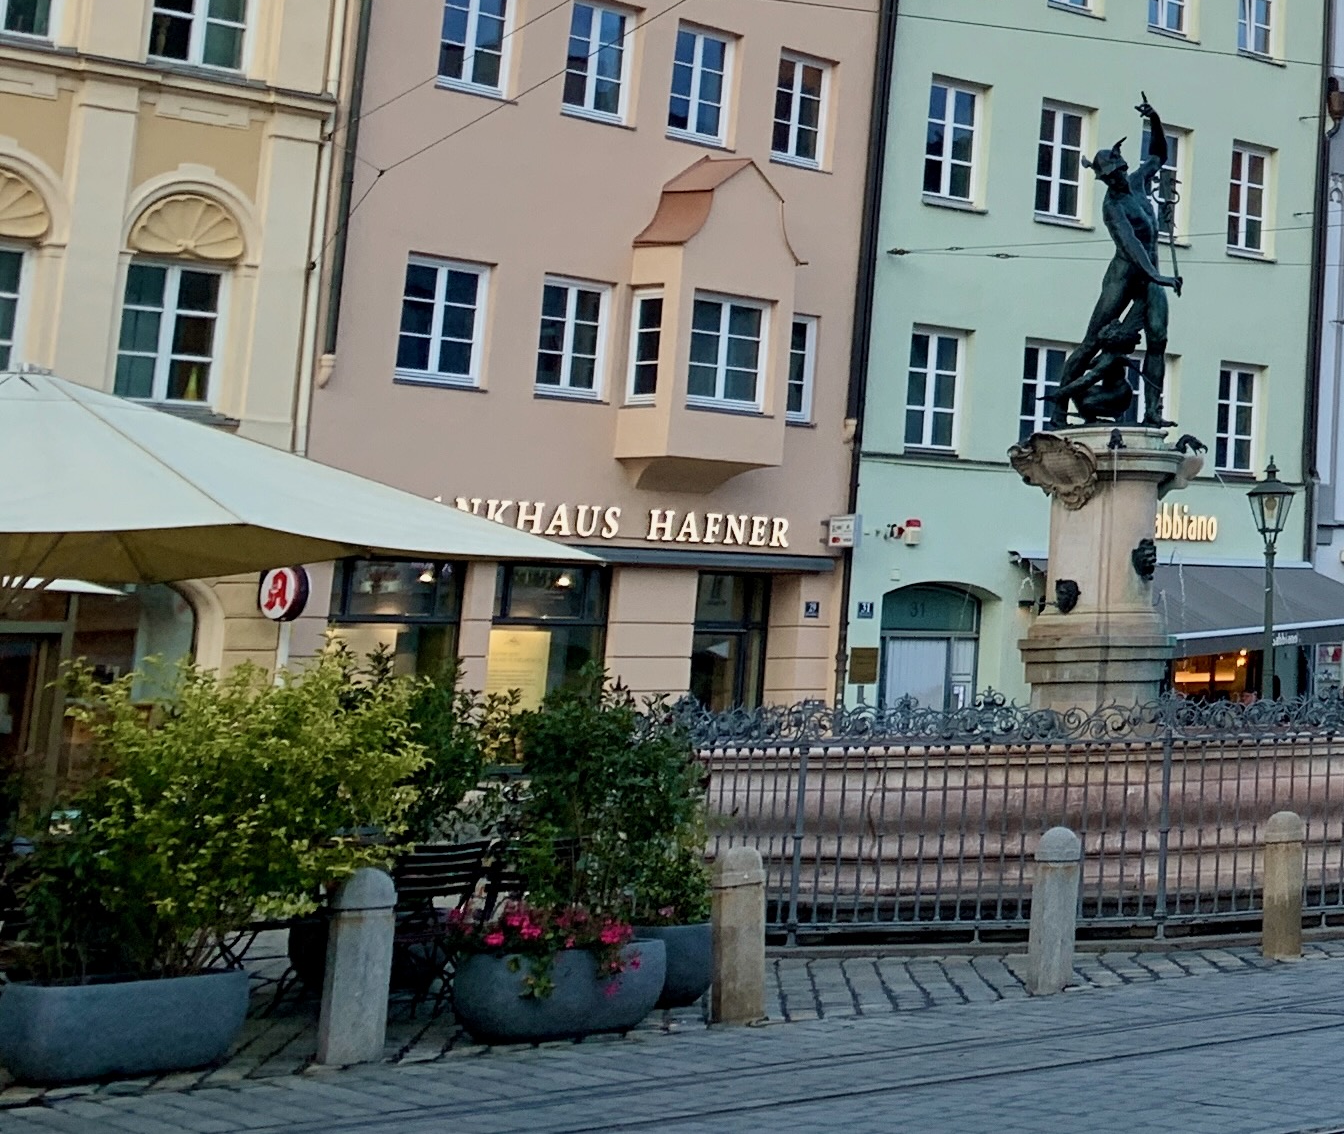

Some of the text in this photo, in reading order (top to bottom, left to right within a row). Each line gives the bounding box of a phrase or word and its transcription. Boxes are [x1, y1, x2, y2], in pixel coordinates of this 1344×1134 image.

[433, 495, 789, 548] NKHAUS HAFNER
[1155, 502, 1217, 541] abbiano
[264, 570, 287, 611] A
[862, 602, 871, 613] 31
[910, 602, 925, 617] 31
[1272, 633, 1298, 646] abbiano
